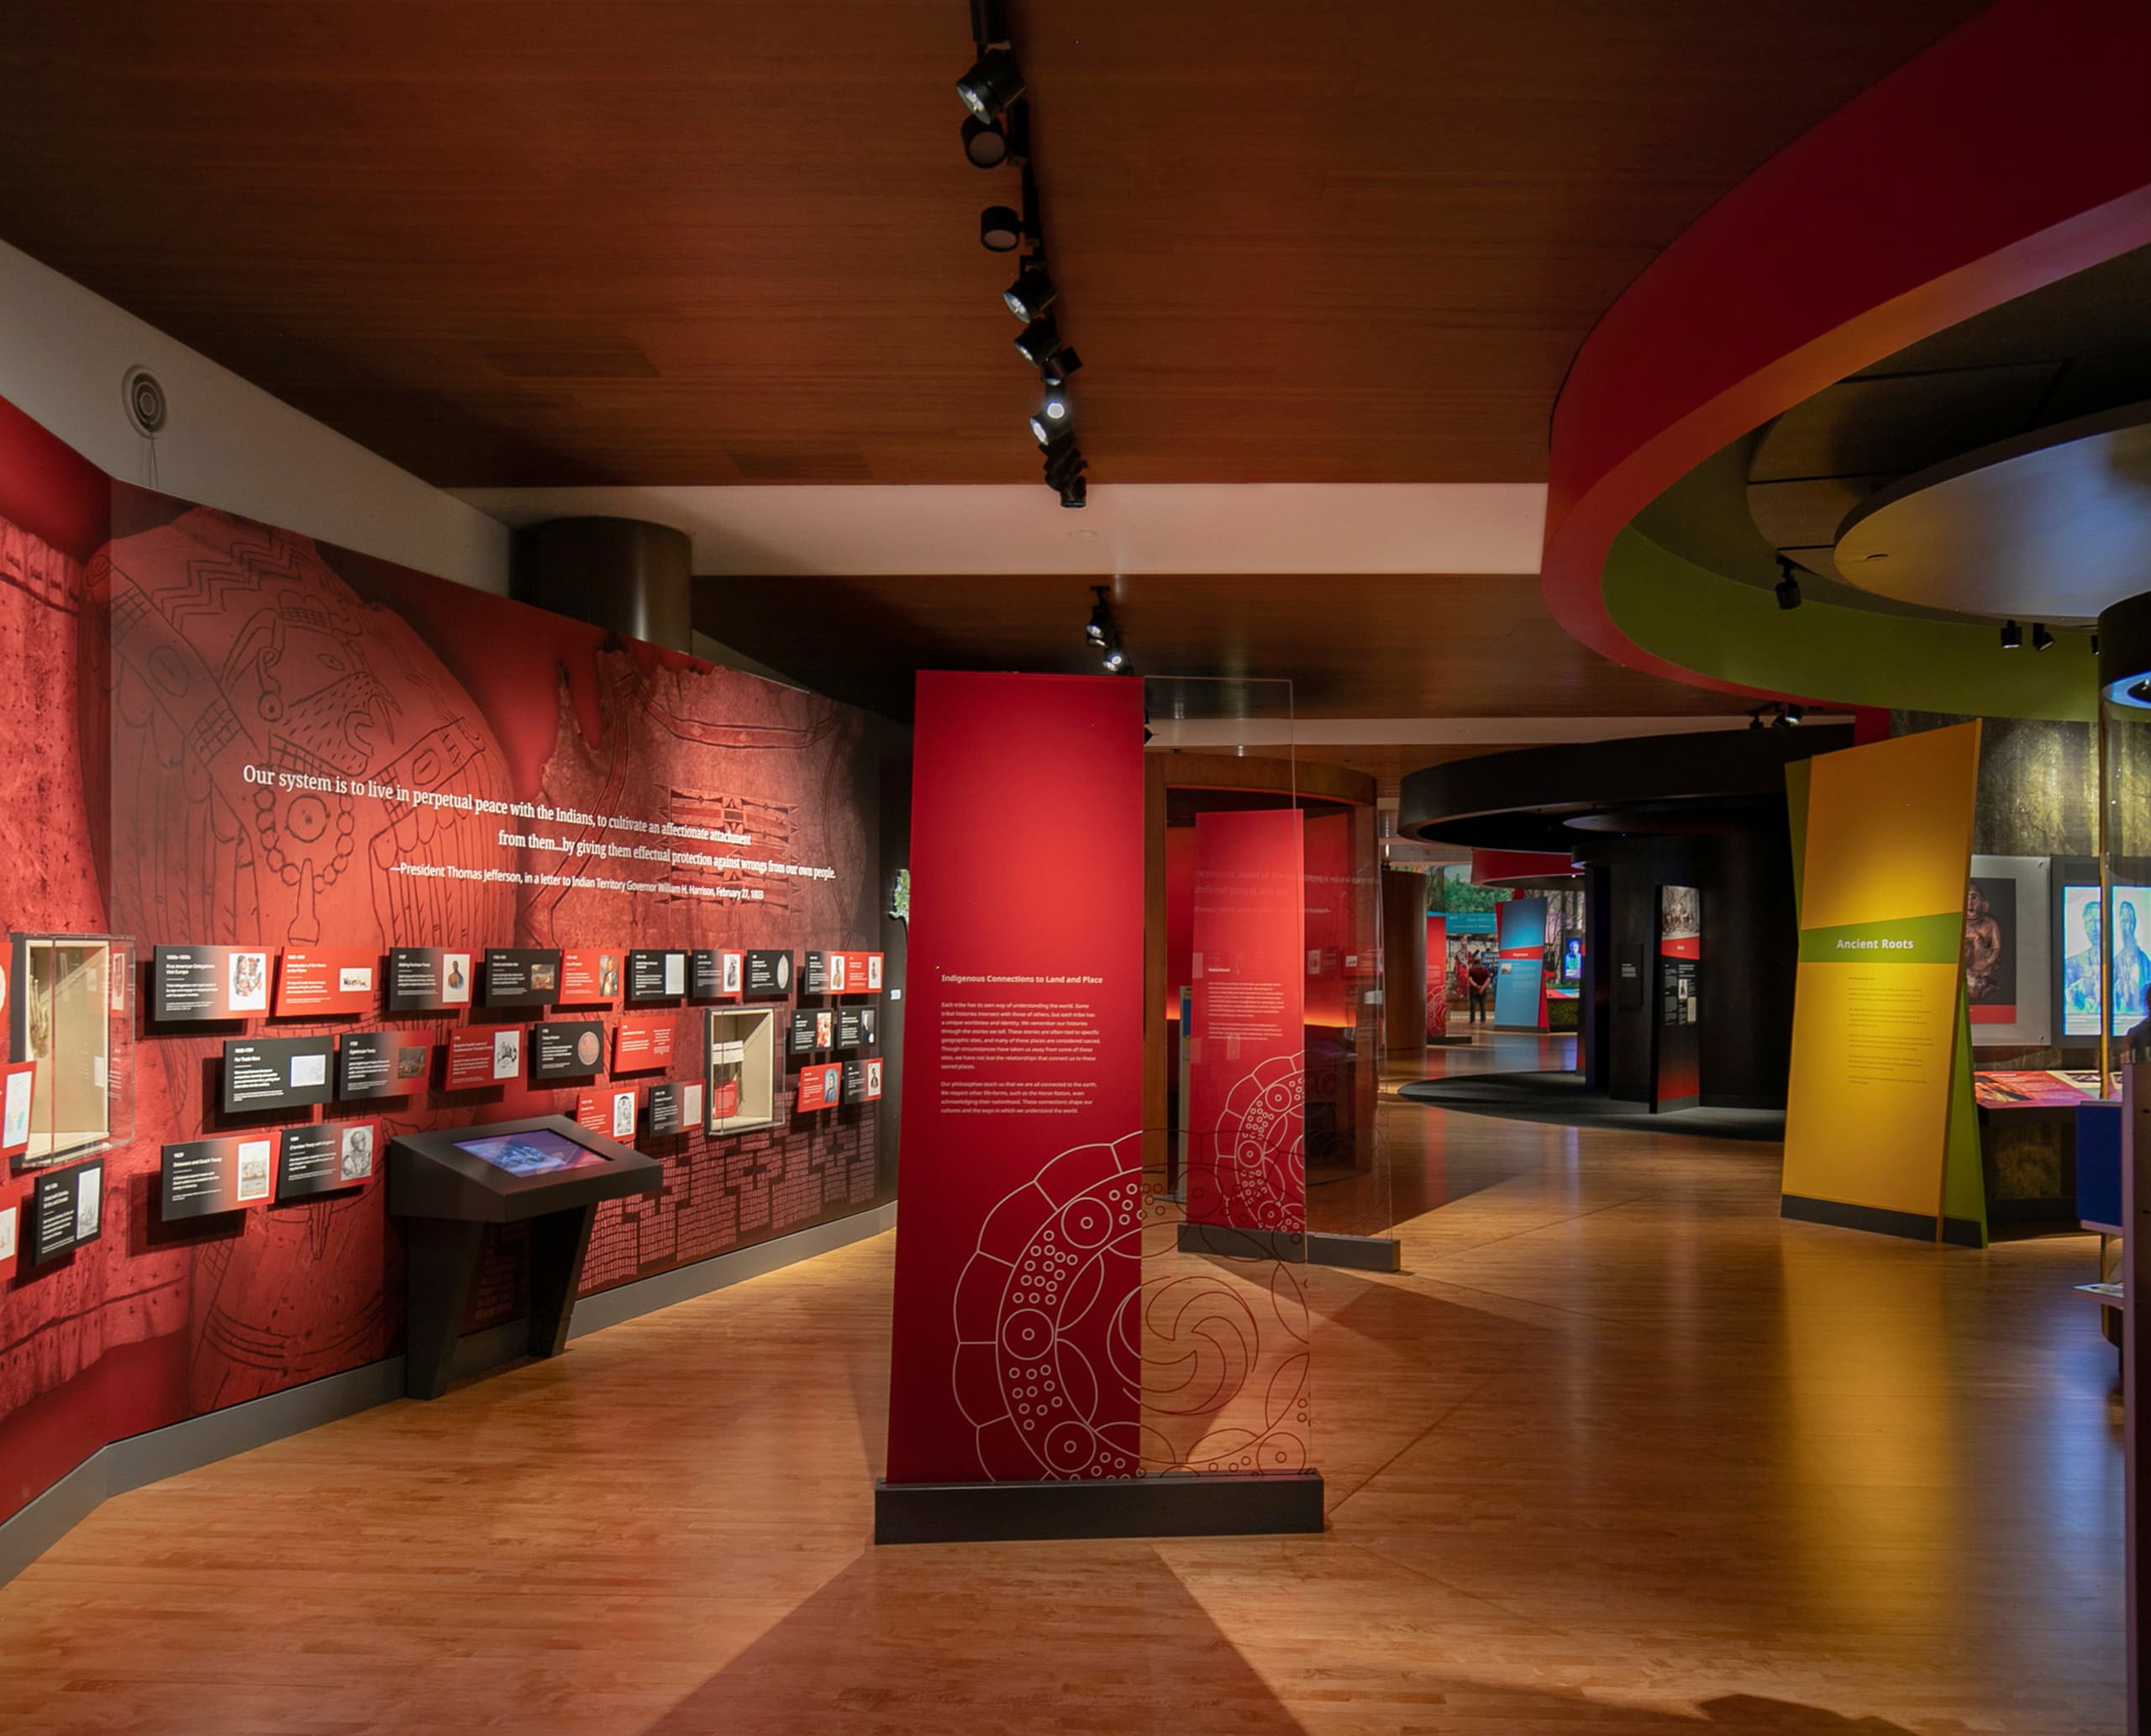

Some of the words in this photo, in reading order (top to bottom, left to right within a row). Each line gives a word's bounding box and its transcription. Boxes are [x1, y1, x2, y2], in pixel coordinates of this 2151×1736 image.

[243, 765, 275, 786] Our
[279, 771, 332, 792] system
[335, 776, 348, 794] is
[351, 781, 365, 796] to
[368, 780, 393, 800] live
[396, 785, 410, 802] in
[413, 788, 473, 811] perpetual
[475, 798, 508, 815] peace
[510, 801, 535, 818] with
[537, 804, 555, 820] the
[556, 807, 596, 828] Indians,
[597, 813, 607, 828] to
[608, 815, 647, 833] cultivate
[649, 822, 660, 834] an
[661, 822, 710, 841] affectionate
[710, 829, 751, 846] attachment
[497, 829, 526, 847] from
[576, 839, 607, 859] giving
[608, 842, 632, 858] them
[634, 845, 671, 862] effectual
[671, 850, 713, 866] protection
[713, 854, 740, 871] against
[741, 860, 768, 875] wrongs
[769, 860, 786, 875] from
[786, 865, 797, 876] our
[798, 866, 813, 877] own
[813, 866, 836, 881] people.
[447, 865, 481, 881] Thomas
[483, 869, 523, 884] Jefferson,
[524, 871, 534, 883] in
[534, 876, 539, 884] a
[540, 873, 561, 886] letter
[563, 876, 571, 886] to
[572, 876, 595, 888] Indian
[597, 877, 626, 892] Territory
[627, 881, 657, 892] Governor
[658, 882, 681, 893] William
[689, 885, 715, 897] Harrison,
[1837, 939, 1879, 949] Ancient
[1882, 939, 1914, 949] Roots
[941, 974, 985, 984] Indigenous
[986, 975, 1034, 983] Connections
[1045, 975, 1065, 984] Land
[1066, 976, 1081, 984] and
[1082, 976, 1103, 984] Place
